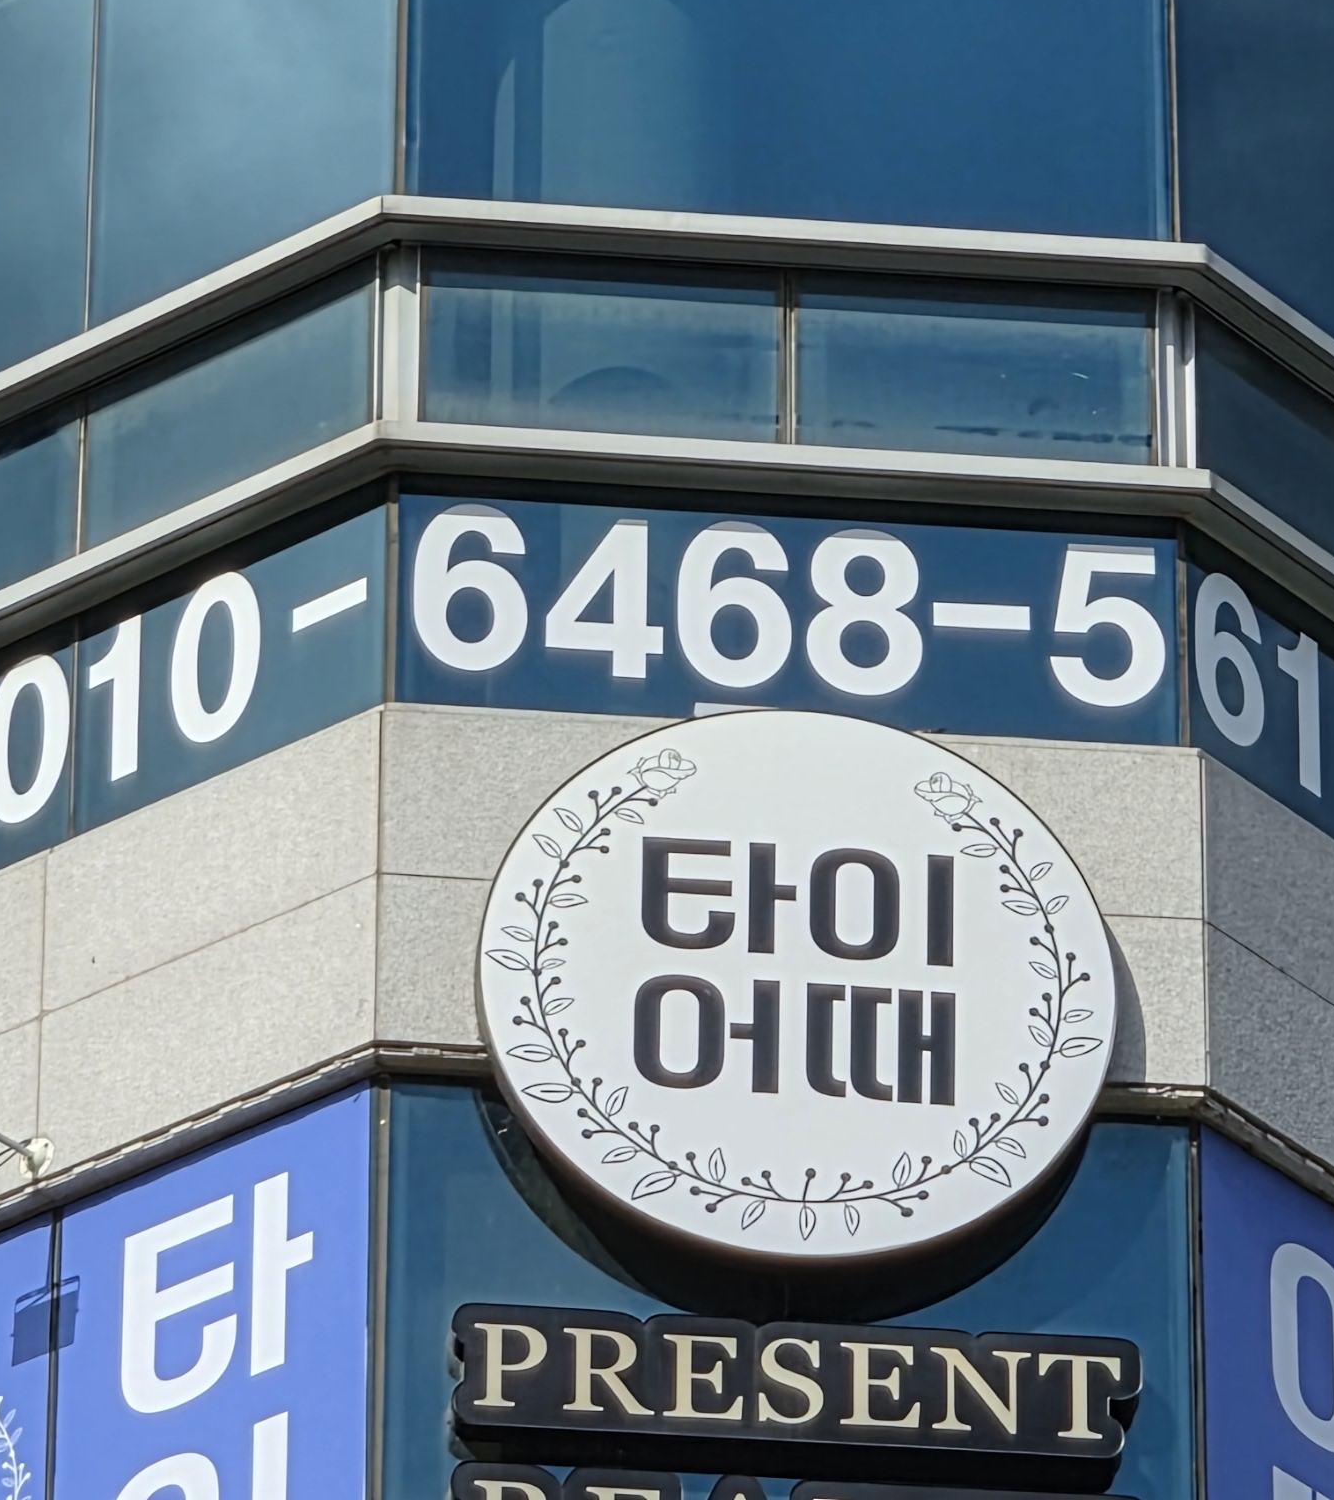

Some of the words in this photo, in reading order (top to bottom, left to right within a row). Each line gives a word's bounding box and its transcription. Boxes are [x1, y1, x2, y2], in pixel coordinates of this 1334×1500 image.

[640, 835, 957, 968] 타이
[633, 973, 958, 1106] 어때
[472, 1321, 1122, 1441] PRESENT
